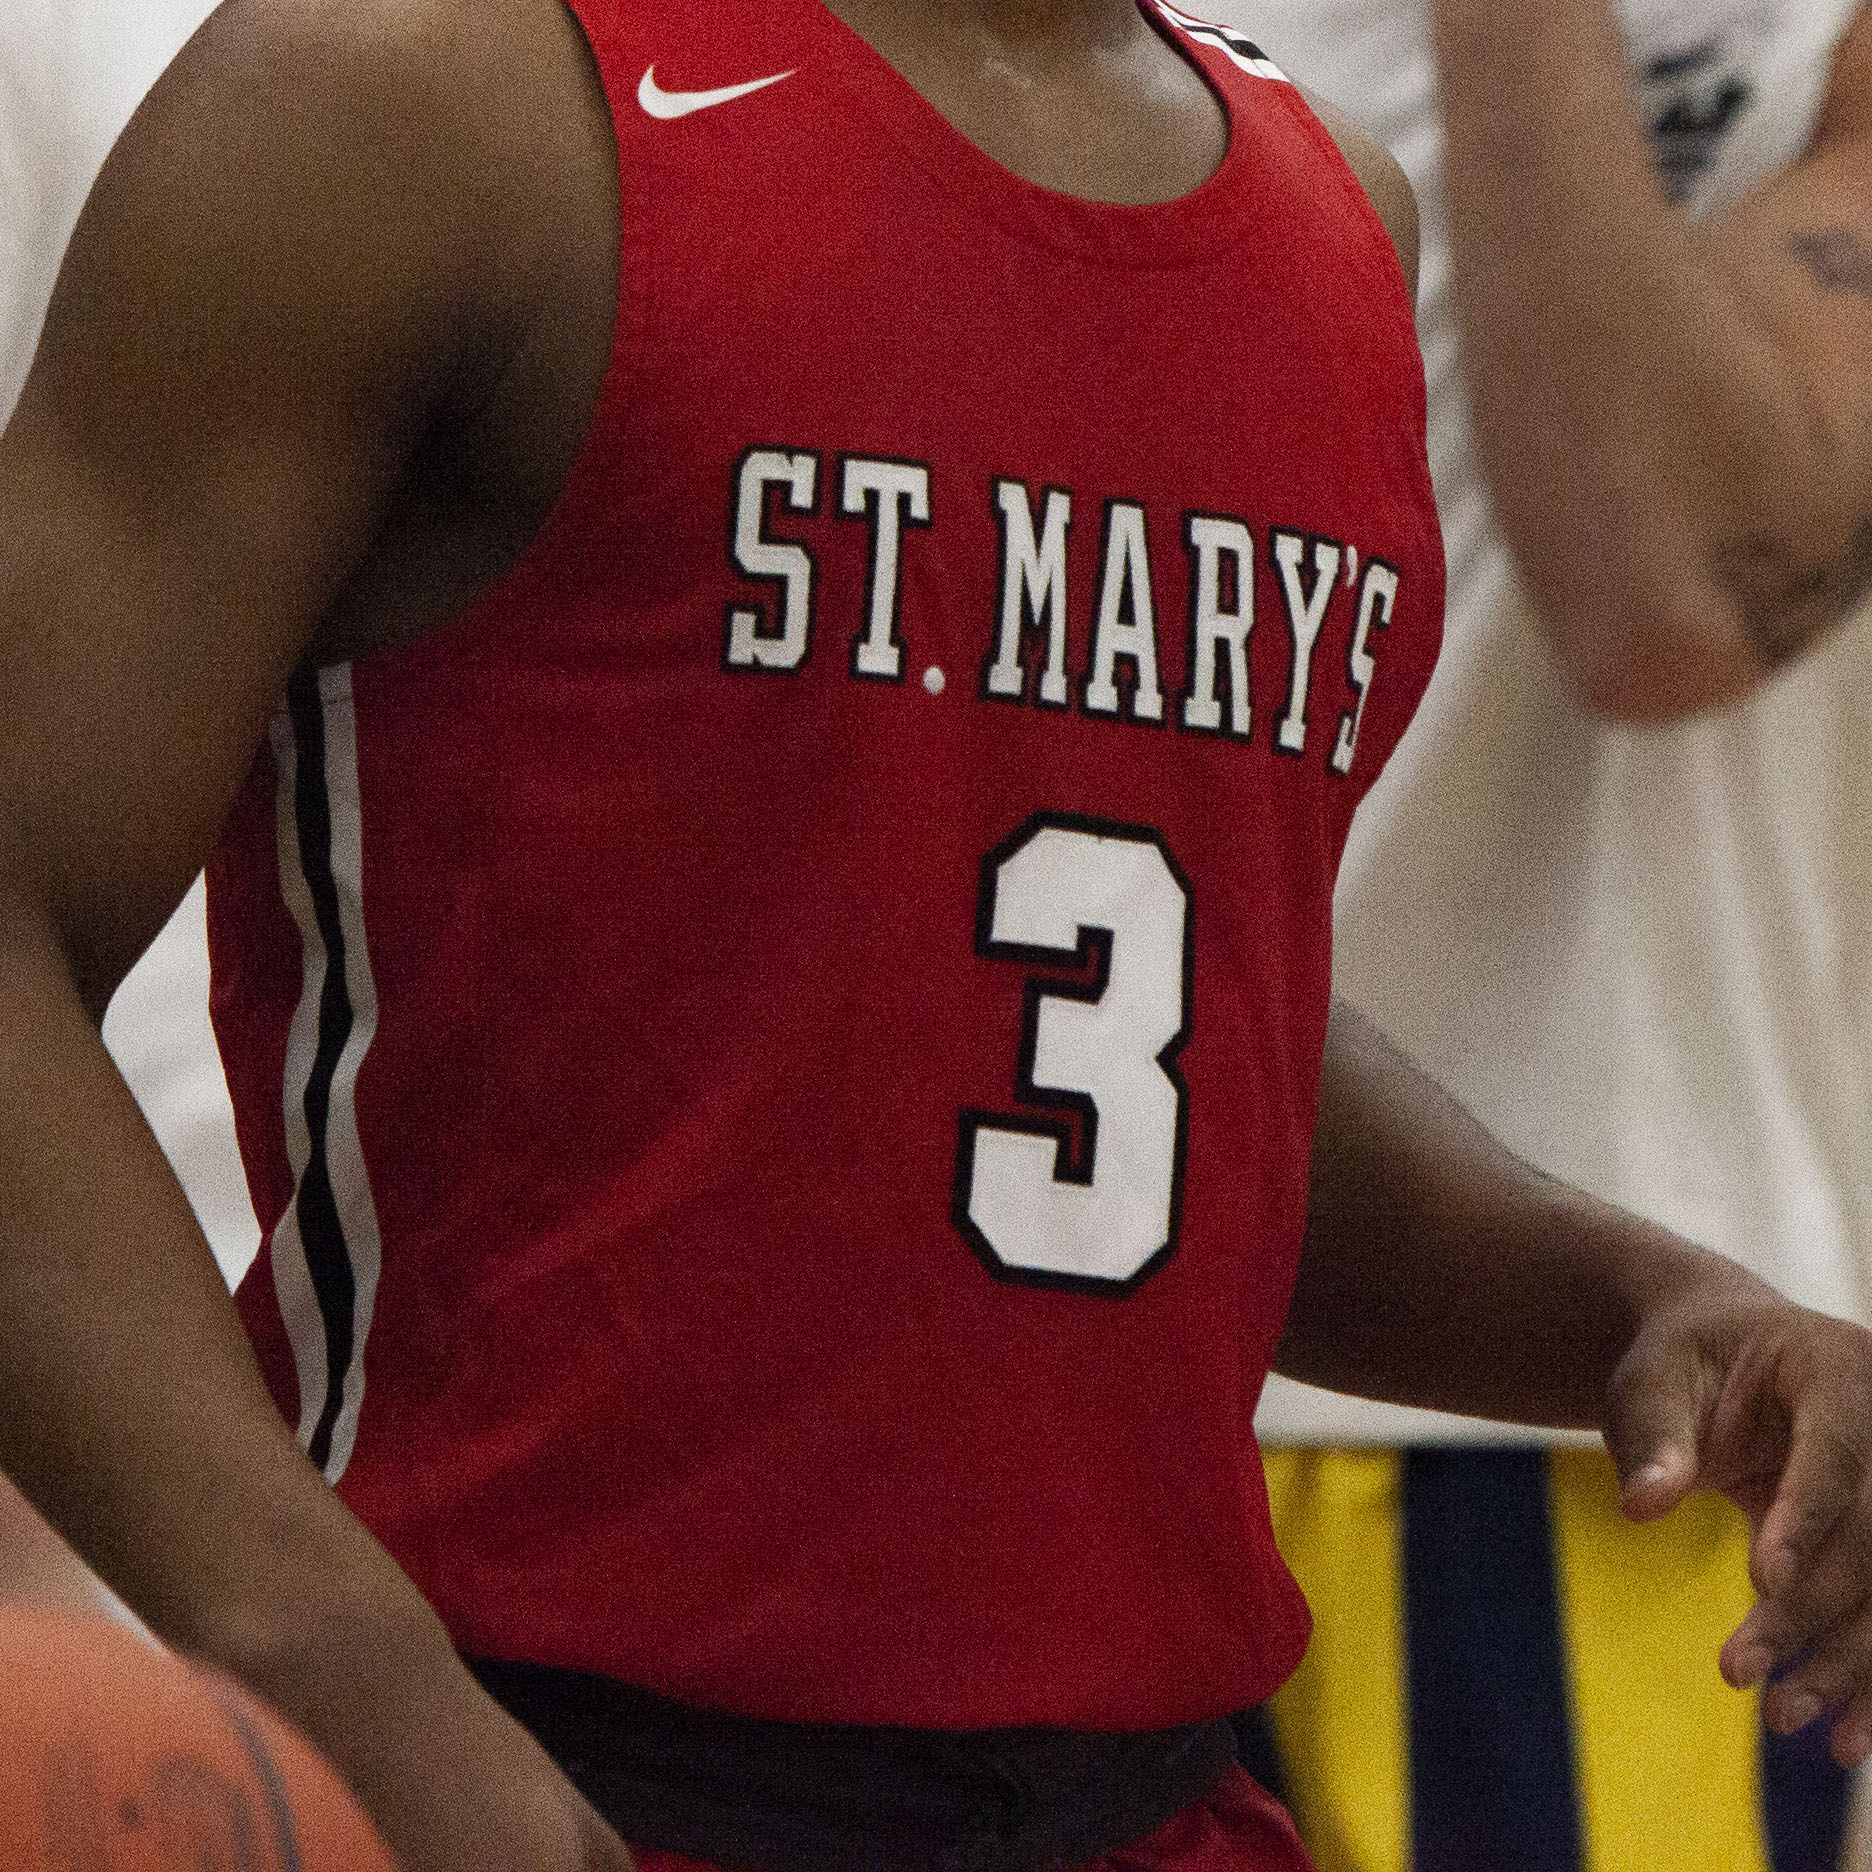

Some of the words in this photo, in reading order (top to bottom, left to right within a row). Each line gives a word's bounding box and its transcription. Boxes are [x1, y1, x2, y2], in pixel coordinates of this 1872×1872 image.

[723, 444, 945, 694] ST.
[979, 473, 1398, 776] MARY'S
[950, 809, 1195, 1299] 3
